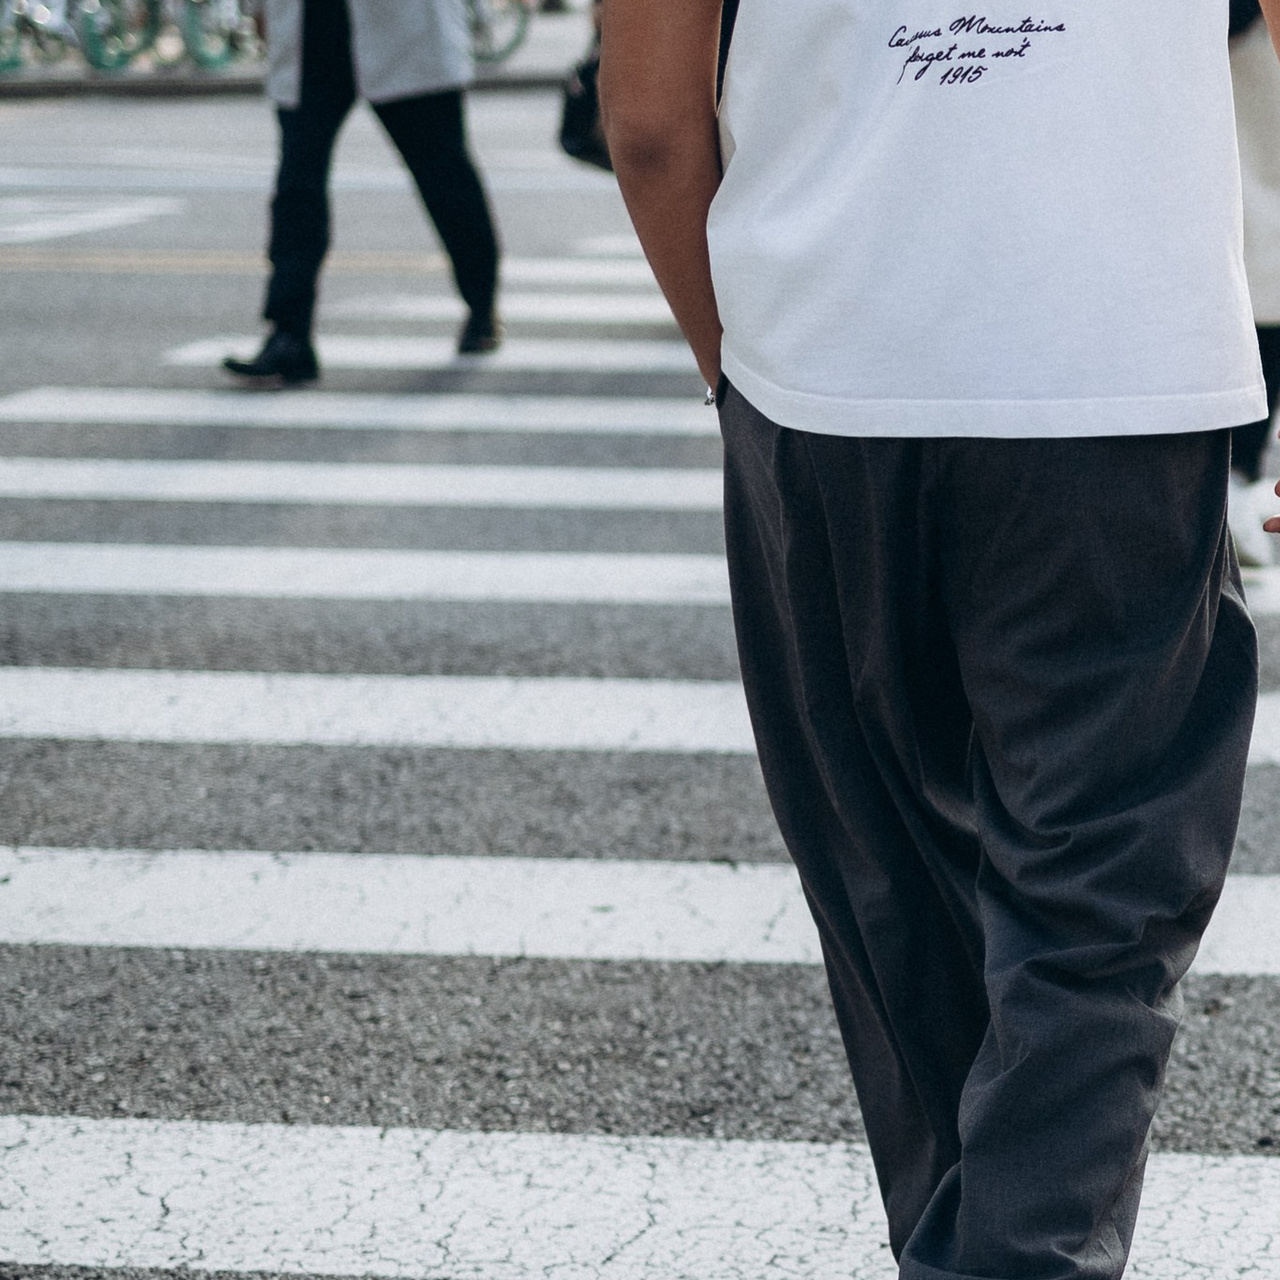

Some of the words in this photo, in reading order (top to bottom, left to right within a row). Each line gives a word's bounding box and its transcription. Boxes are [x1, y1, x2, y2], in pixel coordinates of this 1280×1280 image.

[948, 14, 1066, 36] Mountains
[896, 43, 958, 85] forget
[957, 47, 986, 60] me
[939, 65, 989, 86] 1915
